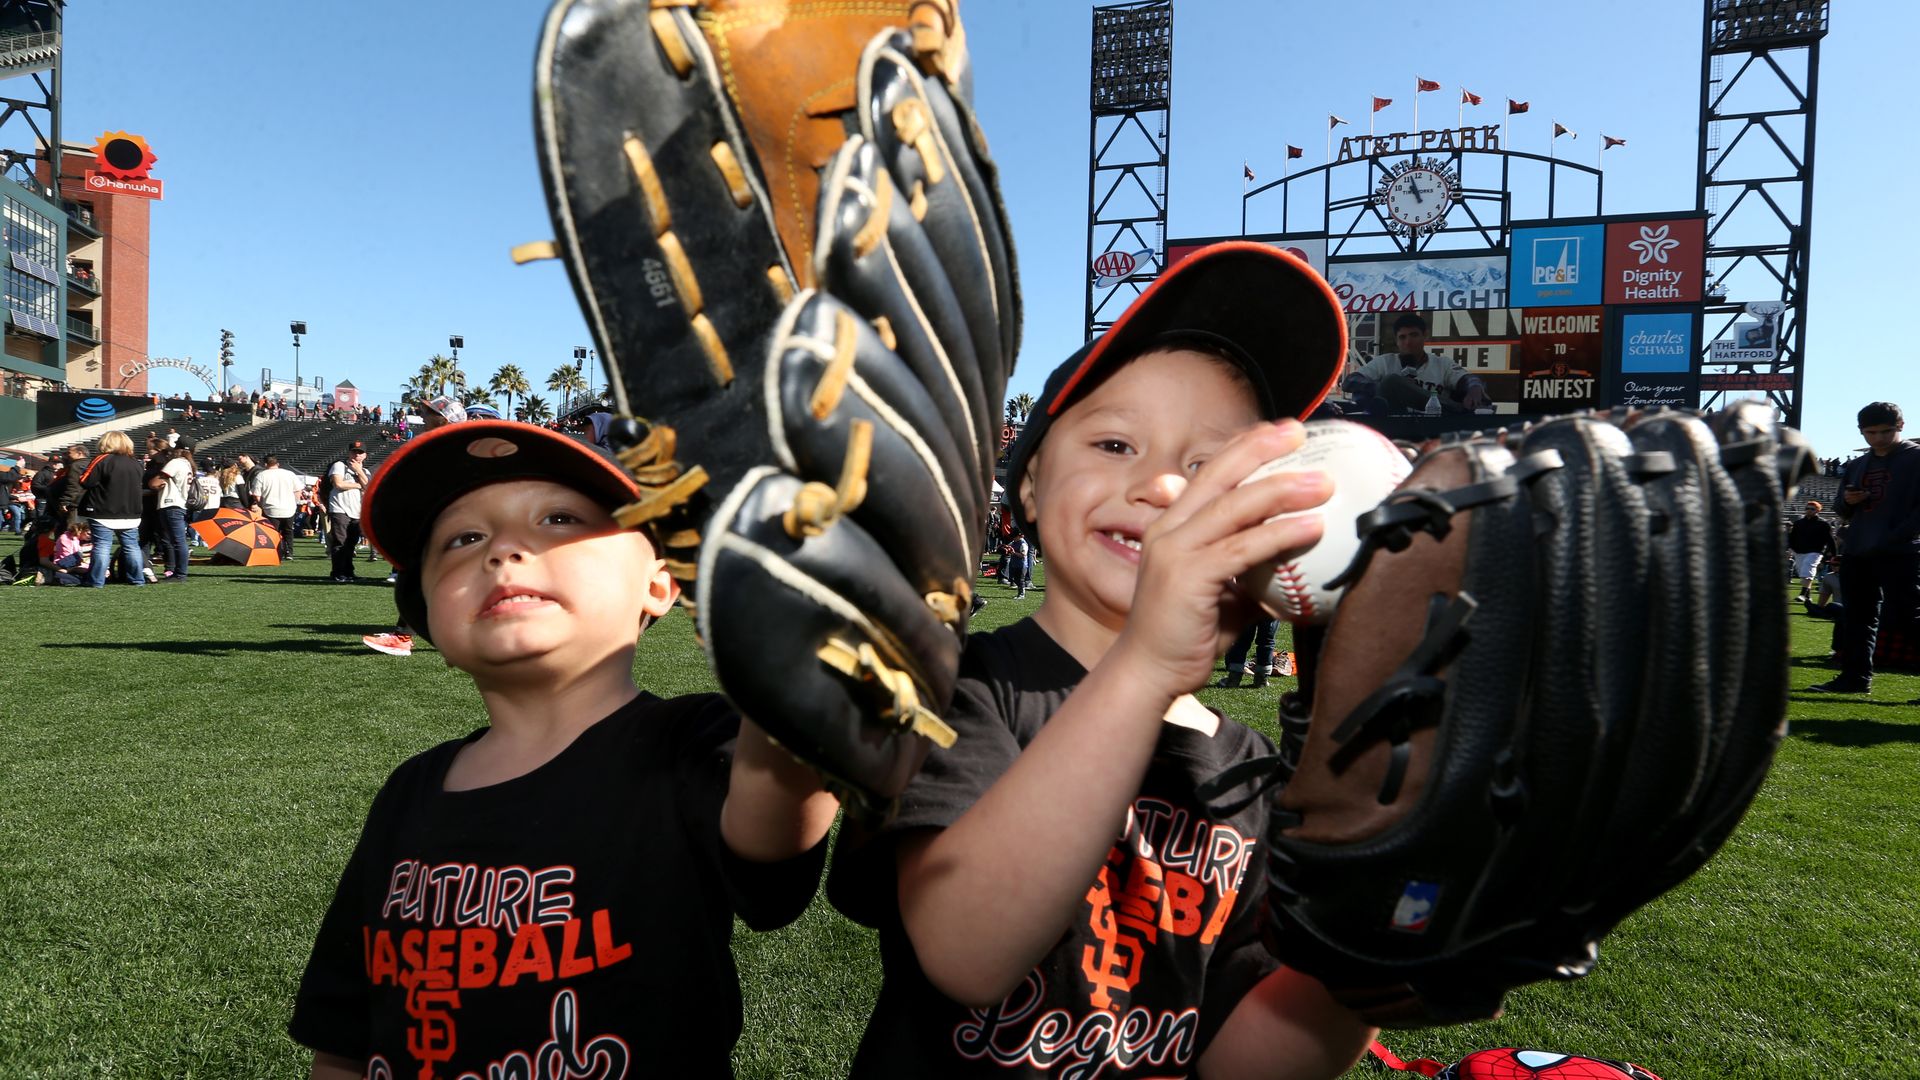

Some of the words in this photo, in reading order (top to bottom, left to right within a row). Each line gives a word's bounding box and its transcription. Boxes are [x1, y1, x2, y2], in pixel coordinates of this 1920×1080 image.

[1337, 132, 1408, 164] AT&T
[1419, 124, 1500, 151] PARK
[1374, 173, 1395, 205] SAN
[1391, 156, 1463, 199] FRANCISCO
[1387, 215, 1449, 238] GIANTS
[1100, 253, 1133, 277] AAA
[1535, 264, 1577, 283] PG&E
[1623, 269, 1682, 286] Dignity
[1333, 284, 1419, 313] Coors
[1422, 288, 1507, 310] LIGHT
[1625, 285, 1680, 300] Health
[1524, 315, 1600, 334] WELCOME
[1629, 330, 1685, 345] charles
[1716, 342, 1736, 350] THE
[1431, 347, 1489, 368] THE
[1554, 343, 1567, 355] TO
[1628, 344, 1685, 356] SCHWAB
[1714, 350, 1774, 360] HARTFORD
[119, 355, 217, 383] Ghirardelli
[1523, 378, 1596, 400] FANFEST
[1623, 381, 1652, 393] Own
[1653, 383, 1686, 398] your
[382, 859, 577, 937] FUTURE
[362, 907, 634, 990] ASEBALL
